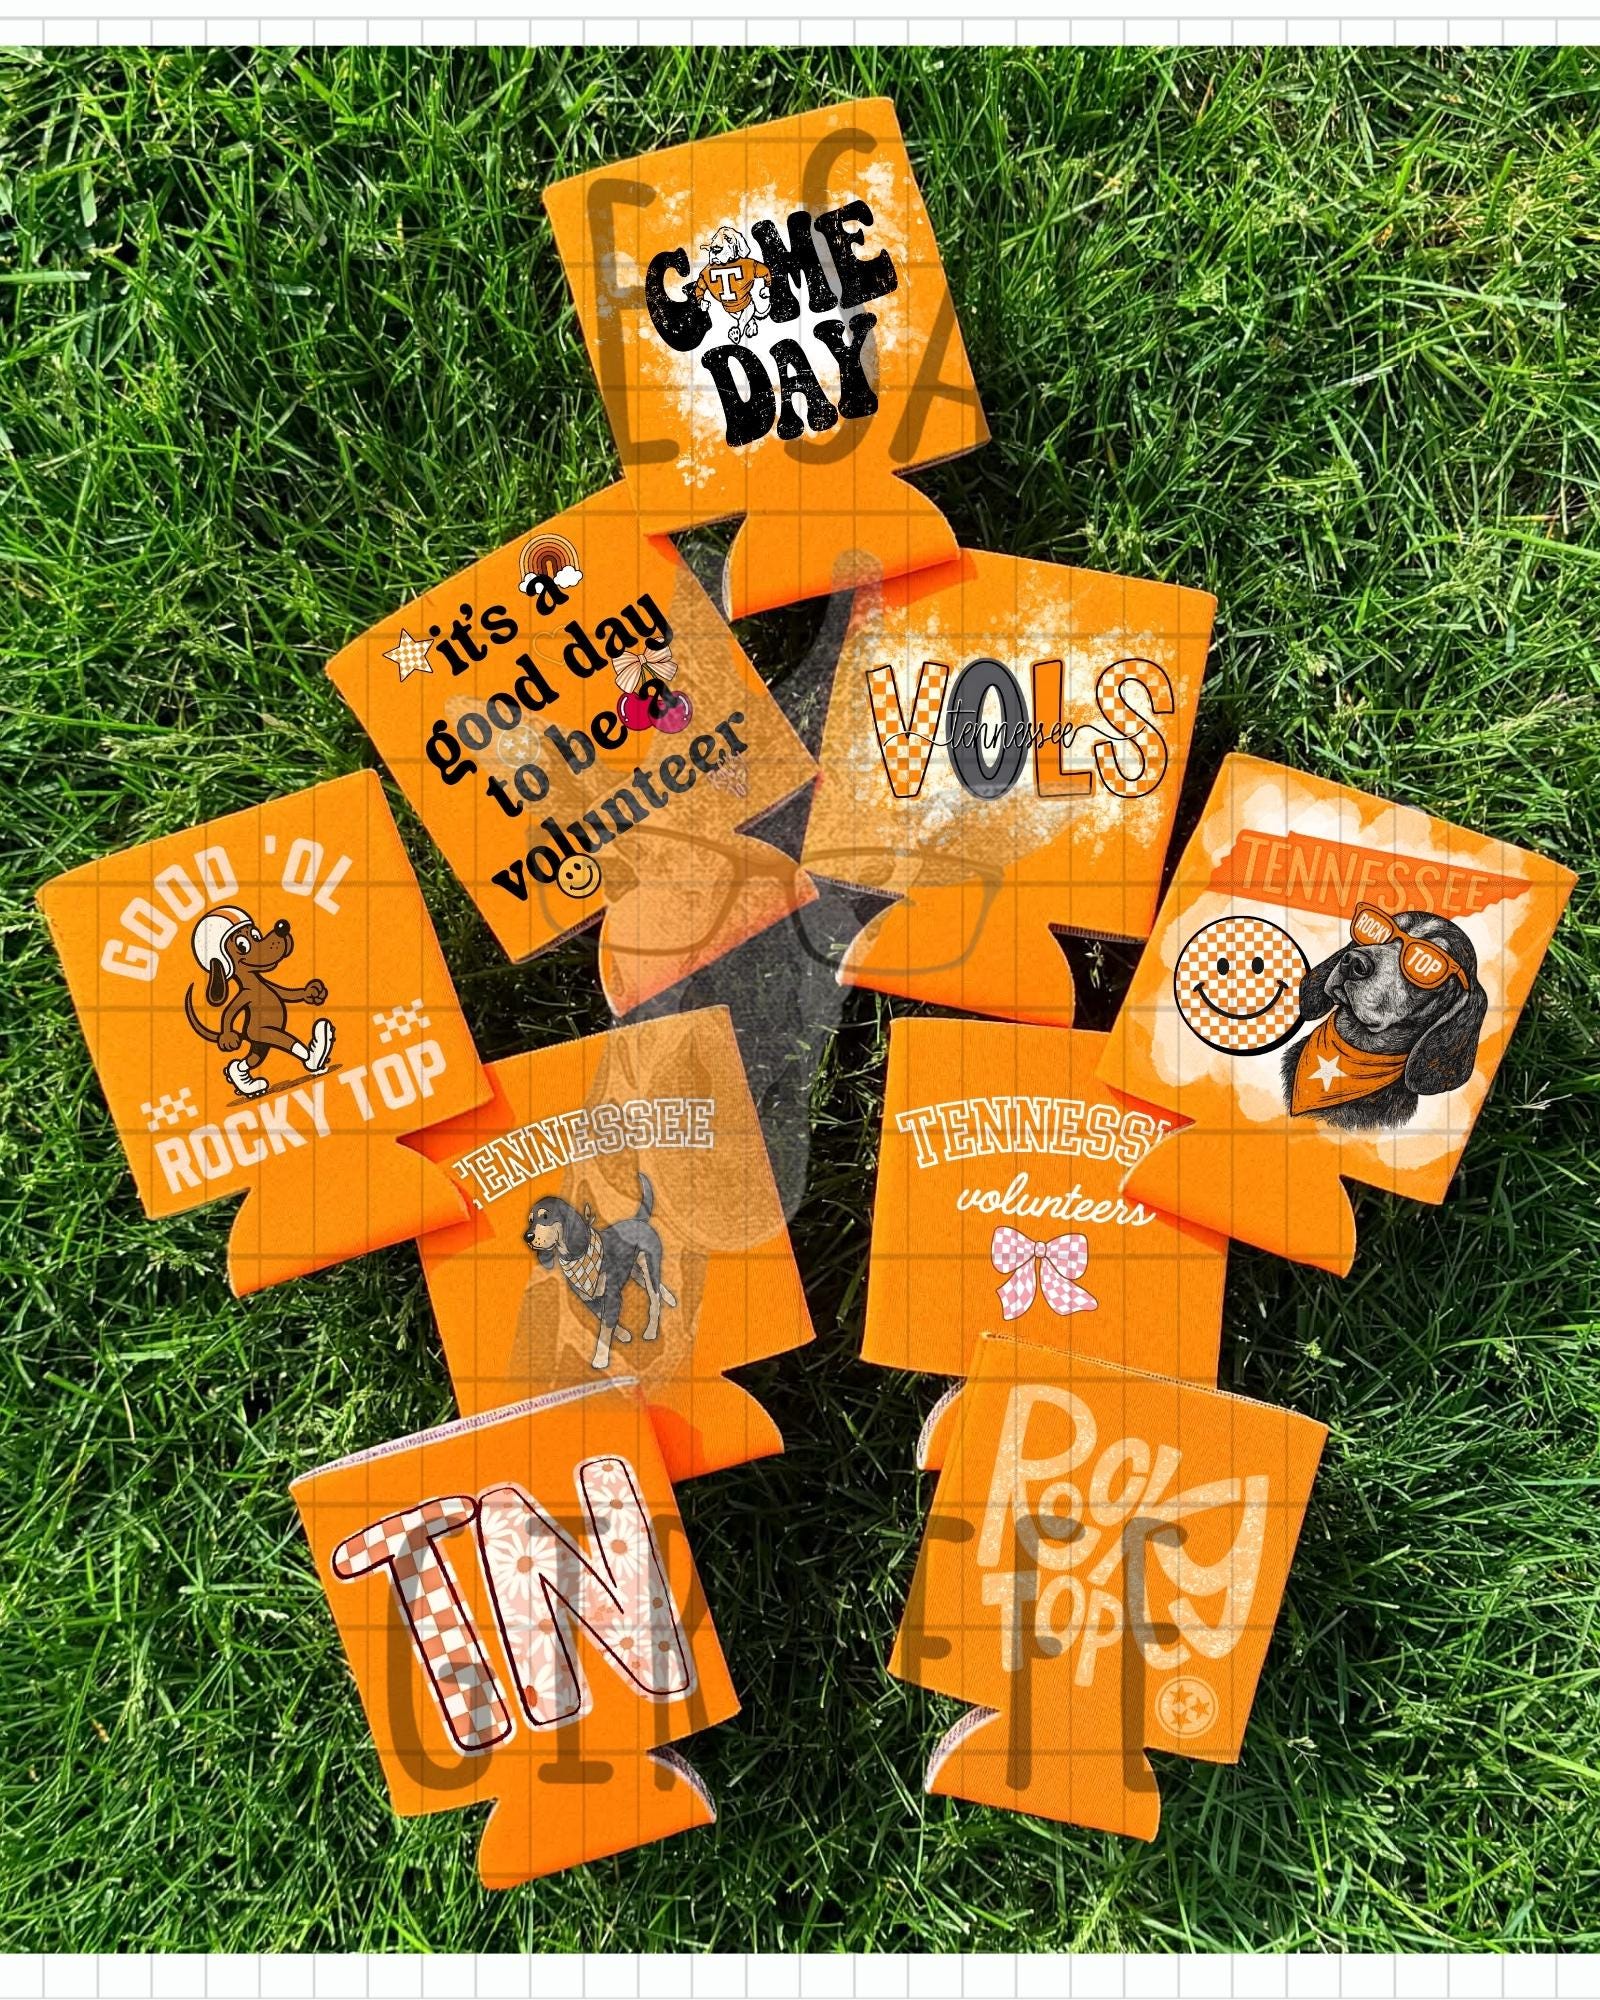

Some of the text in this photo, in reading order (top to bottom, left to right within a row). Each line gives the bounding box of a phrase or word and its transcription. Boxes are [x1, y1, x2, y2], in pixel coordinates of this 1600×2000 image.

[645, 199, 898, 352] GME
[701, 312, 879, 448] DAY
[425, 592, 674, 785] good day
[429, 574, 570, 678] it's a
[486, 677, 679, 818] to be a
[865, 657, 1175, 799] VOLS
[491, 710, 751, 902] volunteer
[1240, 834, 1489, 914] TENNESSEE
[100, 835, 353, 982] GOOD 'OL
[1356, 912, 1442, 978] ROCKY TOP
[154, 1039, 447, 1195] ROCKY TOP
[956, 1171, 1157, 1226] volunteers
[976, 1384, 1270, 1670] ROCKY
[332, 1455, 697, 1755] TN
[981, 1569, 1124, 1687] TOP
